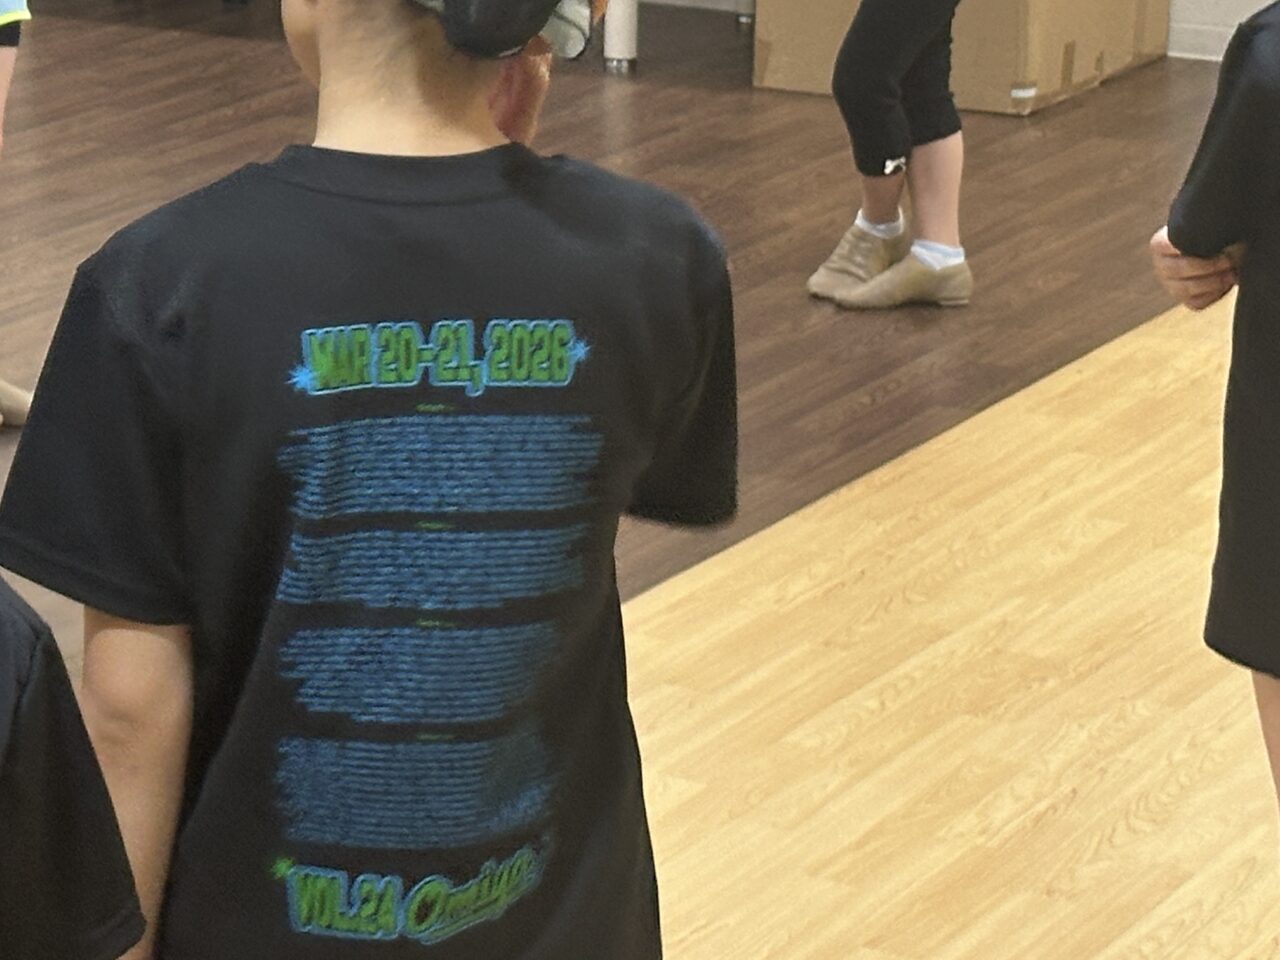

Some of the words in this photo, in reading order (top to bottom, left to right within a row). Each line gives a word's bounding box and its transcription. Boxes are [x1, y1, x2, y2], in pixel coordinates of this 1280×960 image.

[304, 327, 373, 394] MAR
[373, 321, 485, 396] 20-21,
[485, 319, 574, 386] 2026
